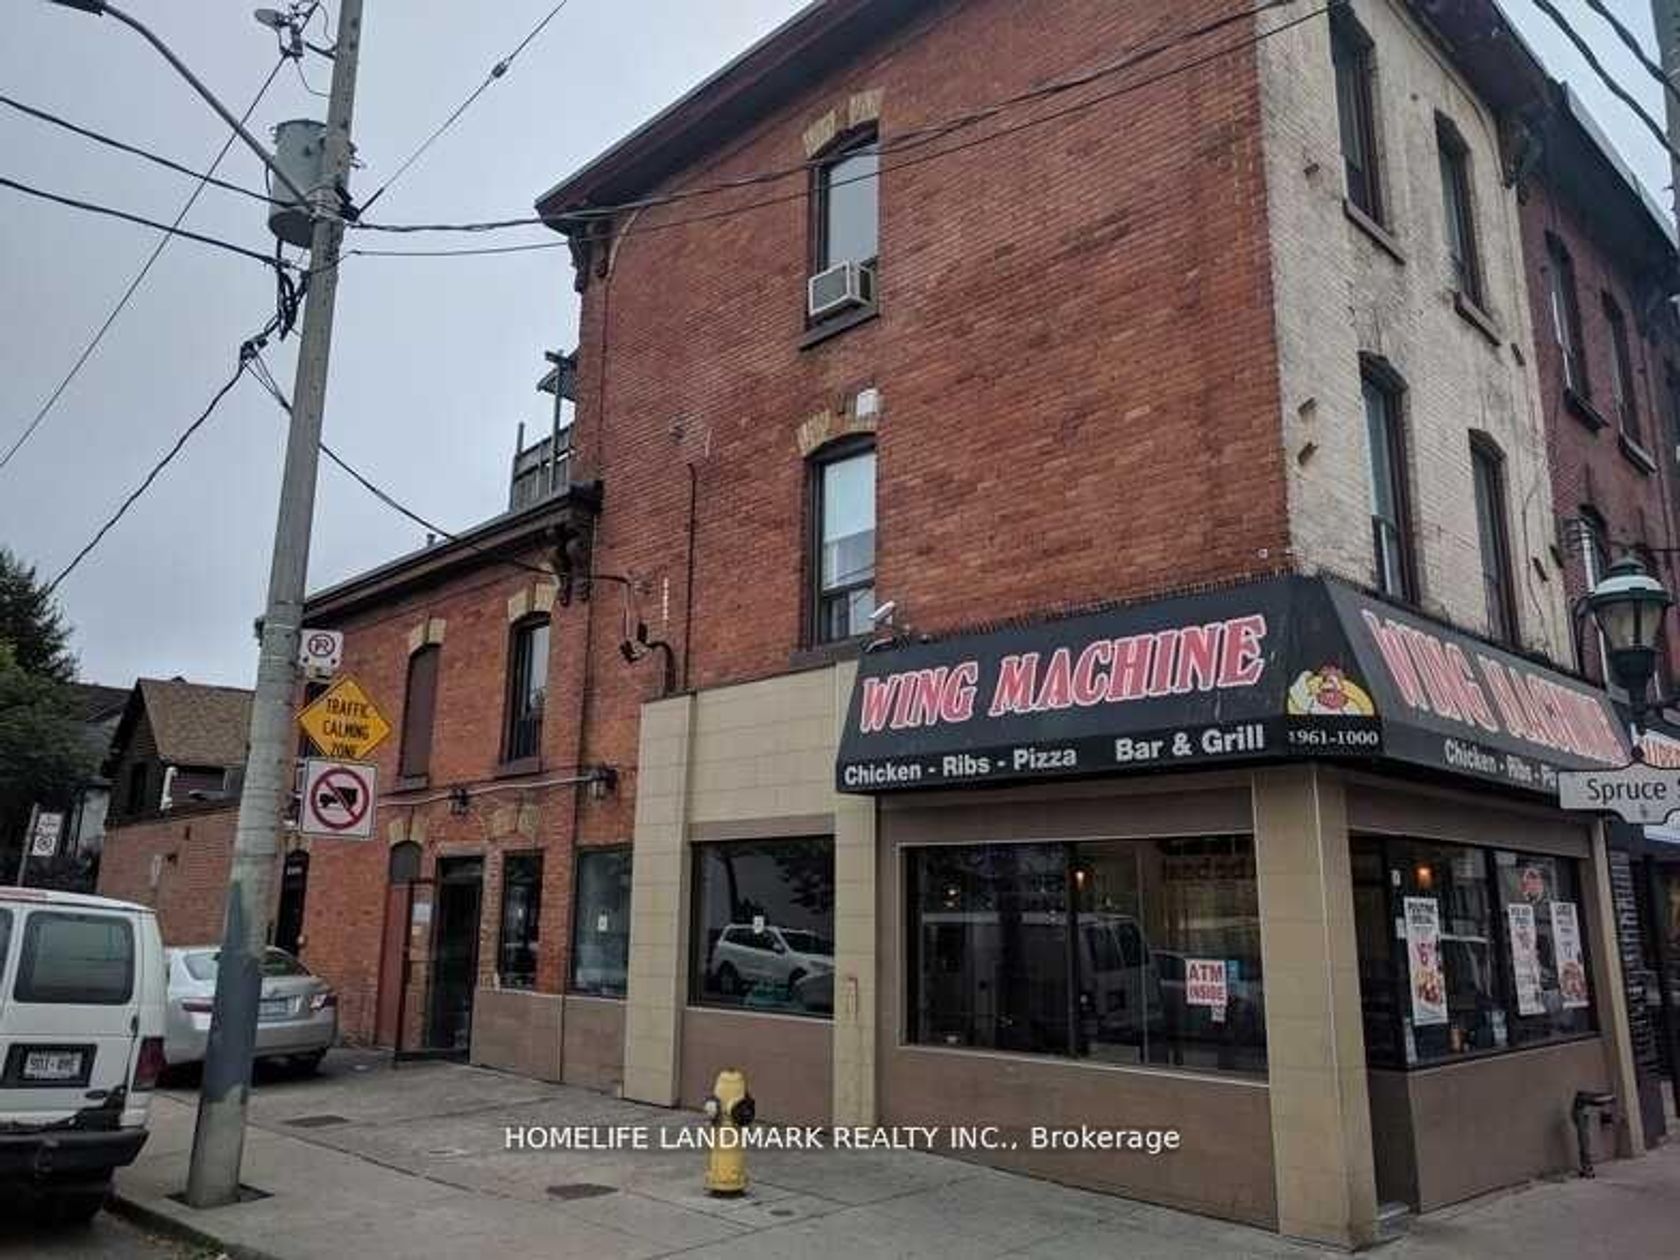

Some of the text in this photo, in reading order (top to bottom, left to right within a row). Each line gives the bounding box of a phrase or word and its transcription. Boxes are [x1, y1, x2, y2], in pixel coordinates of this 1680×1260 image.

[860, 614, 1267, 732] WING MACHINE
[1361, 608, 1500, 732] WING
[326, 697, 373, 719] TRAFFIC
[323, 720, 370, 741] CALMING
[1115, 724, 1264, 762] Bar & Grill
[844, 762, 921, 786] Chicken
[942, 754, 991, 777] Ribs
[1013, 747, 1078, 770] Pizza
[1444, 738, 1497, 773] Chicken
[1587, 778, 1667, 805] Spruce
[1189, 963, 1223, 982] ATM
[1189, 985, 1225, 1001] INSIDE
